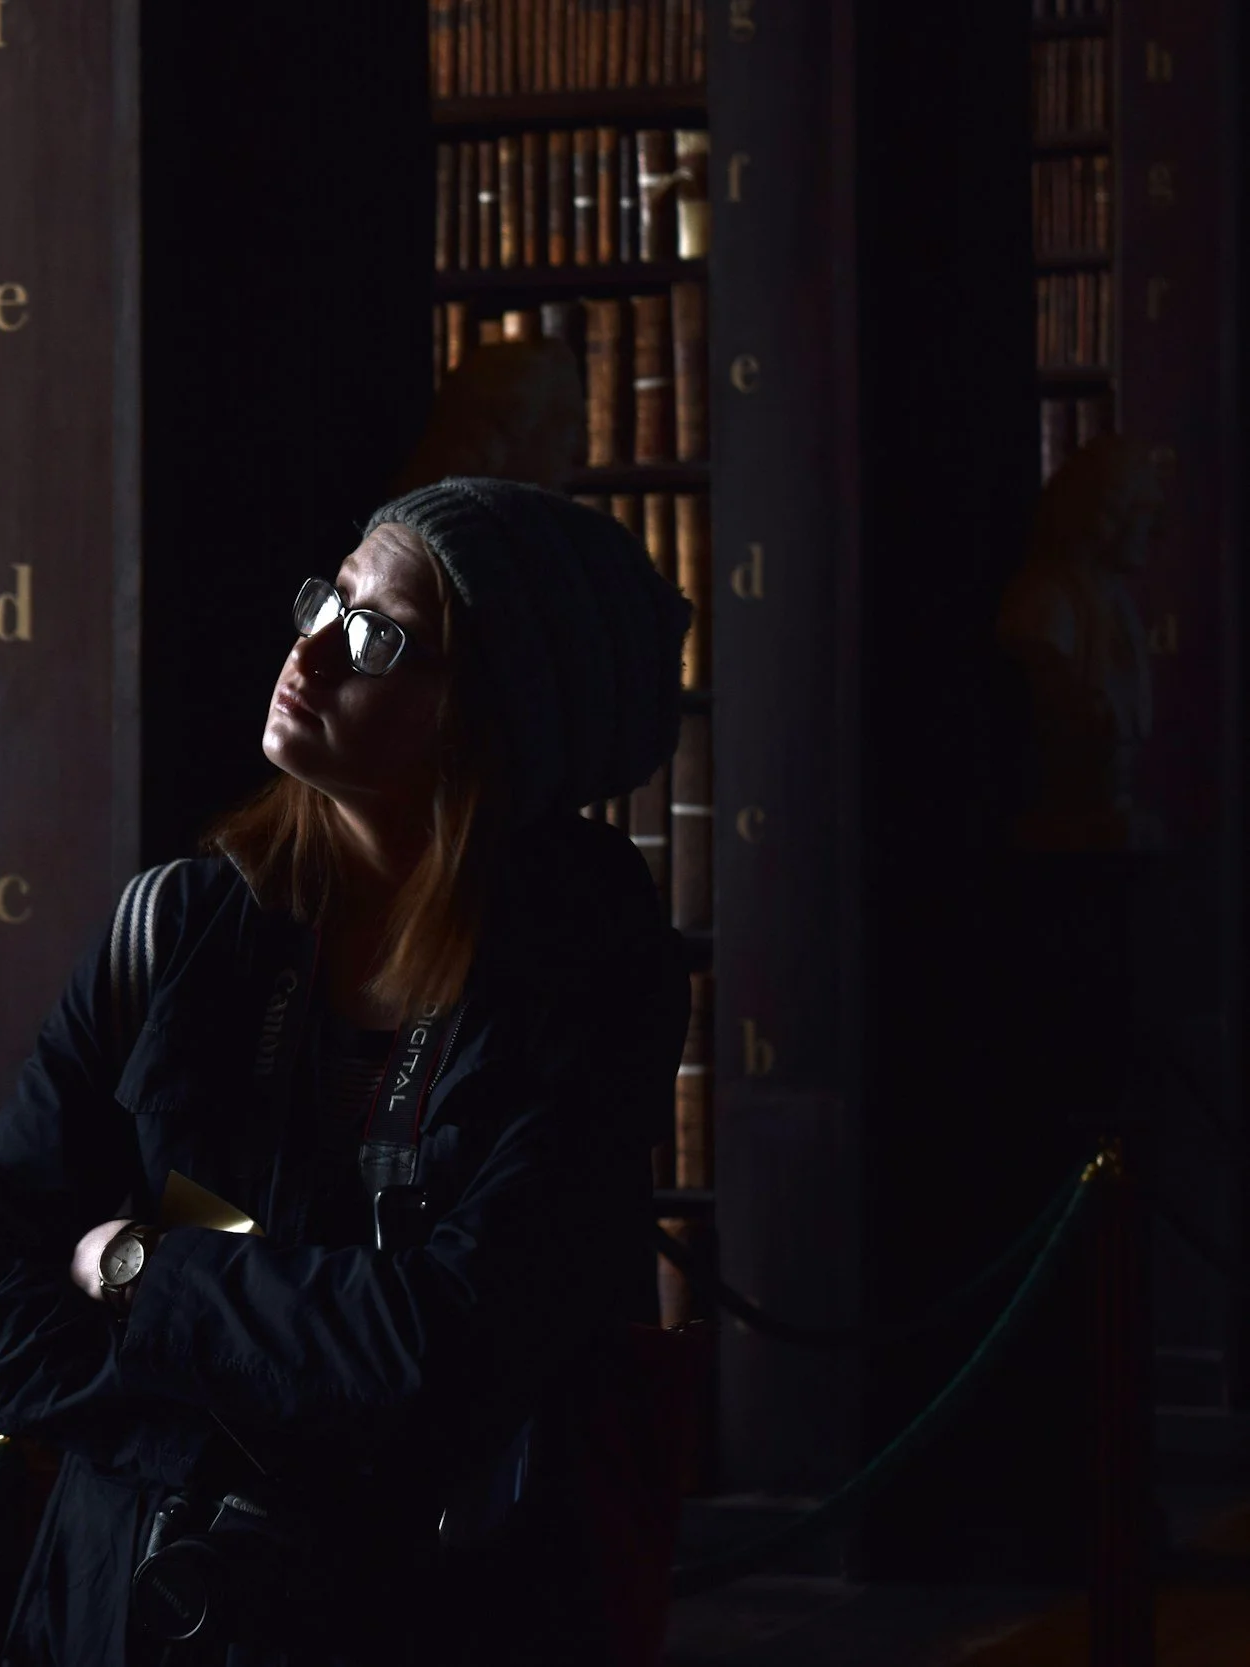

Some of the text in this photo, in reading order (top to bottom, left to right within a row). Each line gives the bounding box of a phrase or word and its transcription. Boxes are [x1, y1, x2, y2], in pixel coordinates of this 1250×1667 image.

[730, 353, 760, 394] e
[730, 541, 765, 600] d
[735, 804, 767, 844] c
[252, 966, 298, 1075] Canon
[741, 1016, 776, 1077] b
